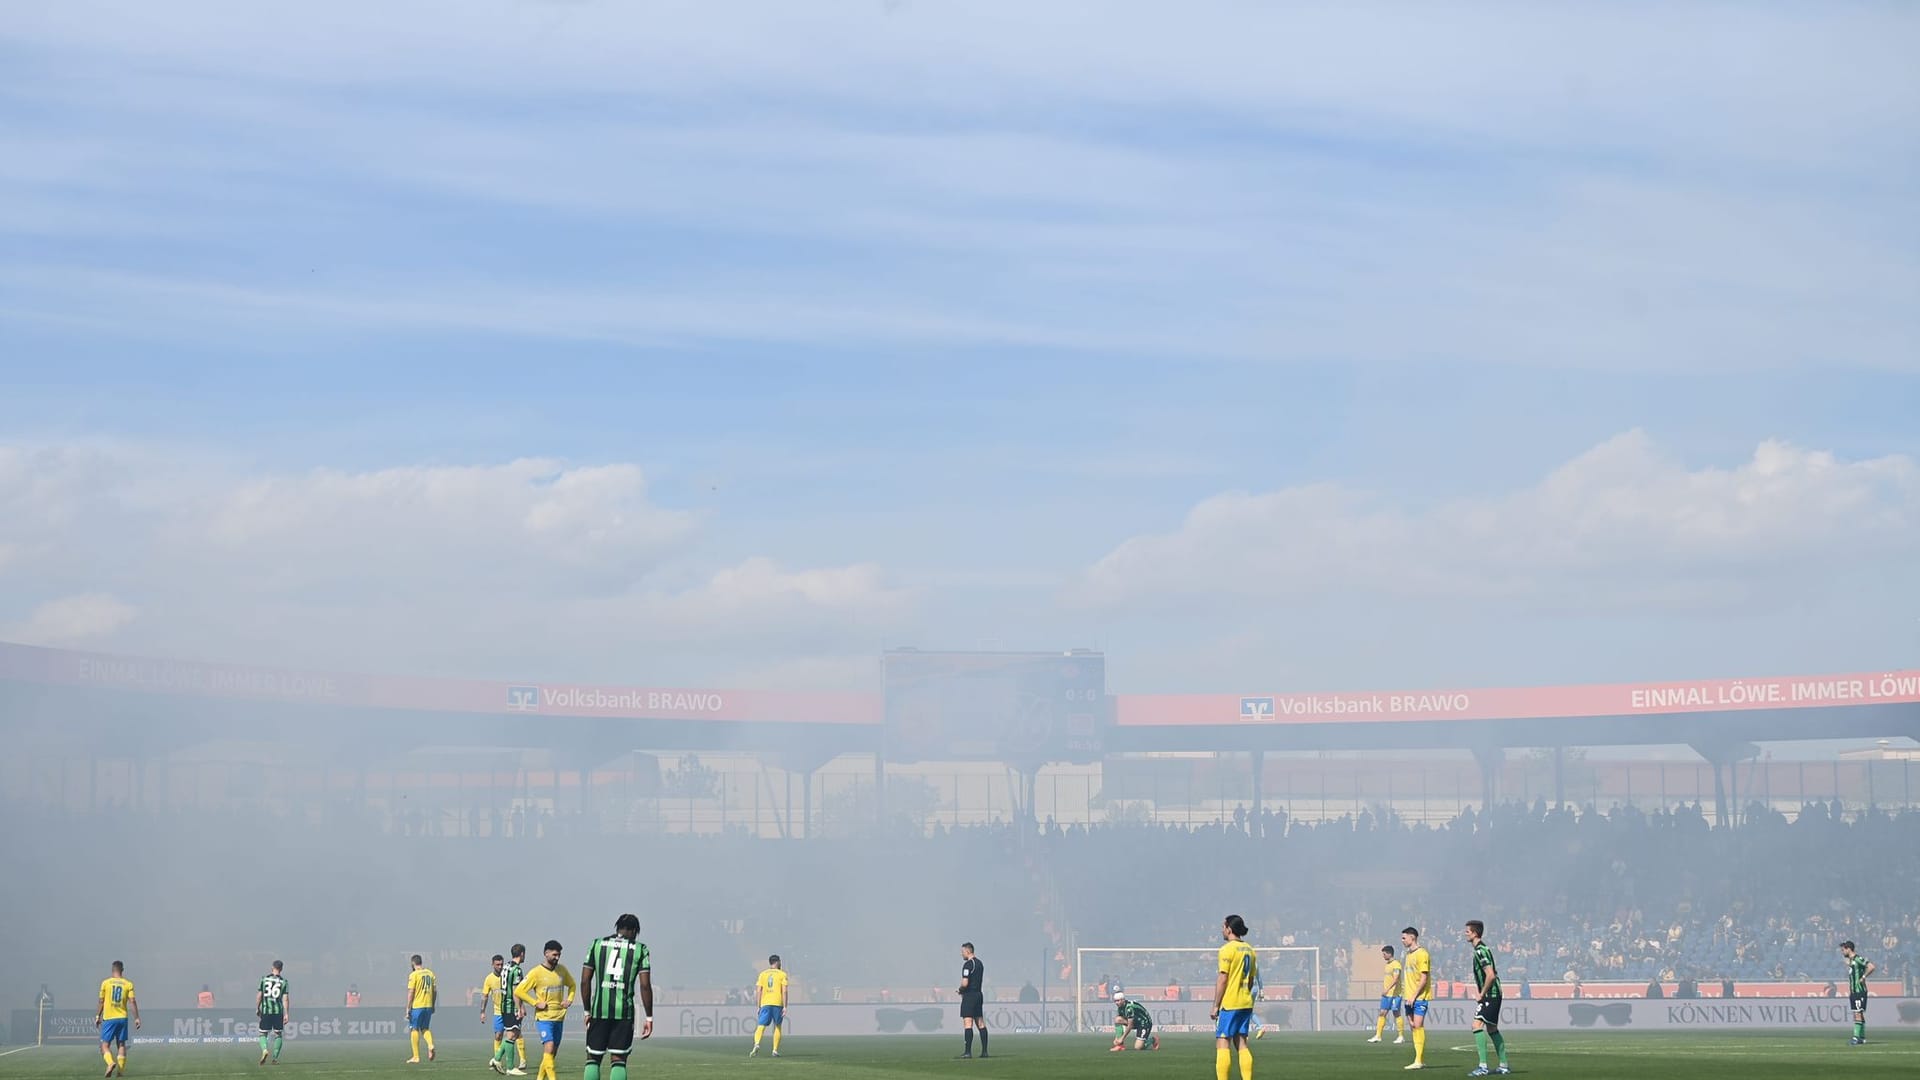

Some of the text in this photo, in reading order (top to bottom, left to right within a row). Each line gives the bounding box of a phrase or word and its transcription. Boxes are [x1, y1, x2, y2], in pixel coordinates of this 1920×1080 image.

[543, 688, 723, 712] Volksbank BRAWO
[1280, 694, 1470, 714] Volksbank BRAWO
[1631, 687, 1715, 708] EINMAL
[1719, 680, 1786, 704] LÖWE.
[1792, 680, 1865, 701] IMMER
[606, 949, 623, 975] 4
[111, 985, 123, 1003] 18
[263, 981, 282, 998] 36
[1428, 1006, 1467, 1026] WIR
[1500, 1006, 1535, 1025] CH.
[1667, 1002, 1752, 1023] KÖNNEN
[1758, 1005, 1798, 1023] WIR
[173, 1018, 212, 1036] Mit
[218, 1017, 342, 1039] Teageist
[347, 1020, 397, 1035] zum
